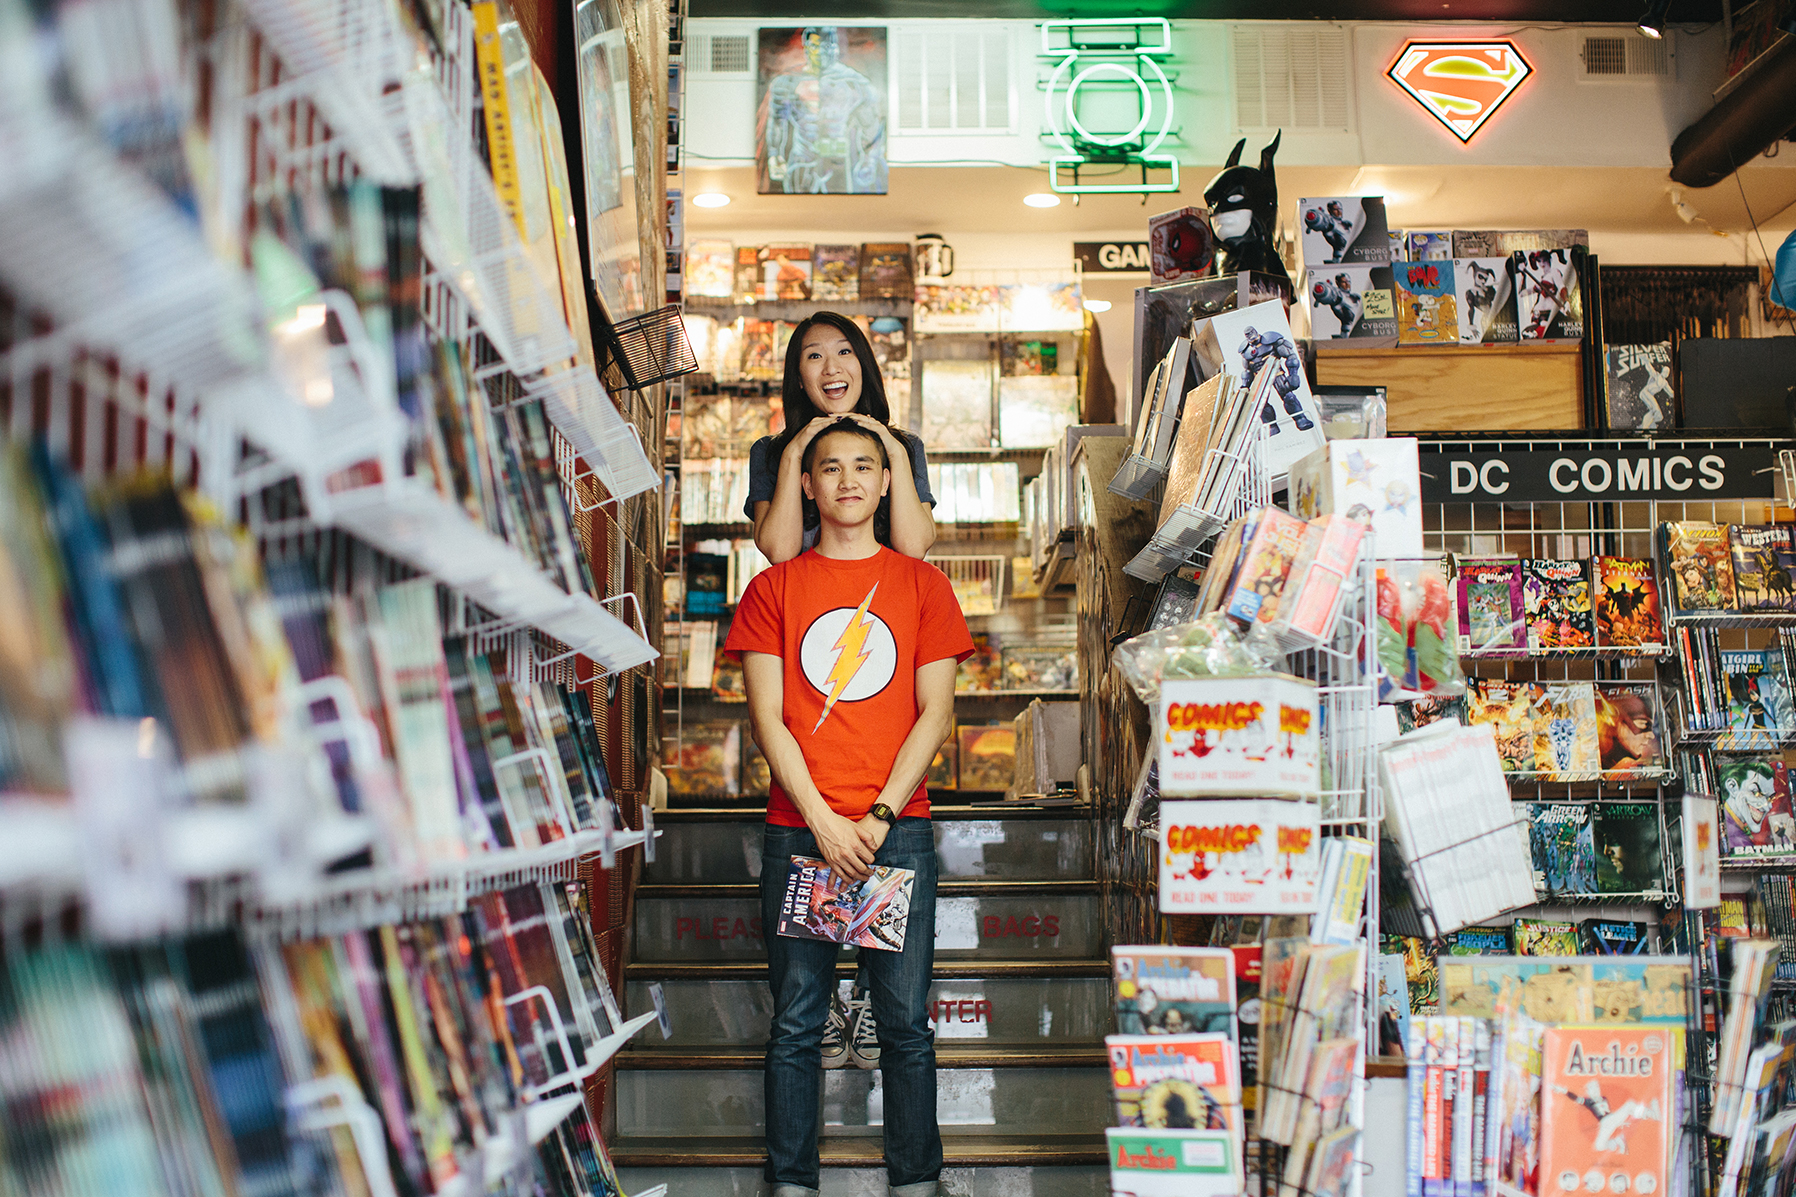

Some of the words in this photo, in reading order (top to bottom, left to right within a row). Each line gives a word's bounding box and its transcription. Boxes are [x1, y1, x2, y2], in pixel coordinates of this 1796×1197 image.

[1353, 248, 1388, 256] CYBORG
[1407, 265, 1440, 287] BONE
[1361, 322, 1397, 330] CYBORG
[1618, 343, 1667, 359] SILVER
[1450, 459, 1510, 494] DC
[1549, 454, 1725, 493] COMICS
[1741, 528, 1790, 546] WESTERN
[1463, 566, 1503, 576] HARLEY
[1532, 559, 1575, 570] HARLEY
[1607, 559, 1650, 573] BATMAN
[1477, 572, 1513, 584] QUINN
[1546, 568, 1580, 580] QUINN
[1533, 685, 1591, 708] FLASH
[1608, 684, 1653, 697] FLASH
[1166, 700, 1266, 732] COMICS
[1534, 809, 1589, 824] ARROW
[1550, 804, 1586, 816] GREEN
[1606, 804, 1653, 816] ARROW
[1166, 823, 1264, 854] COMICS
[1733, 843, 1795, 855] BATMAN
[782, 872, 799, 915] CAPTAIN
[792, 866, 818, 926] AMERICA
[983, 916, 1060, 938] BAGS
[1526, 924, 1572, 933] JUSTICE
[1600, 931, 1637, 942] LEAGUE
[1458, 940, 1506, 949] PEOPLE
[1564, 1040, 1654, 1077] Archie
[1474, 1095, 1485, 1114] THE
[1473, 1115, 1485, 1160] MARRIED
[1117, 1145, 1177, 1170] Archie
[1472, 1160, 1484, 1182] LIFE
